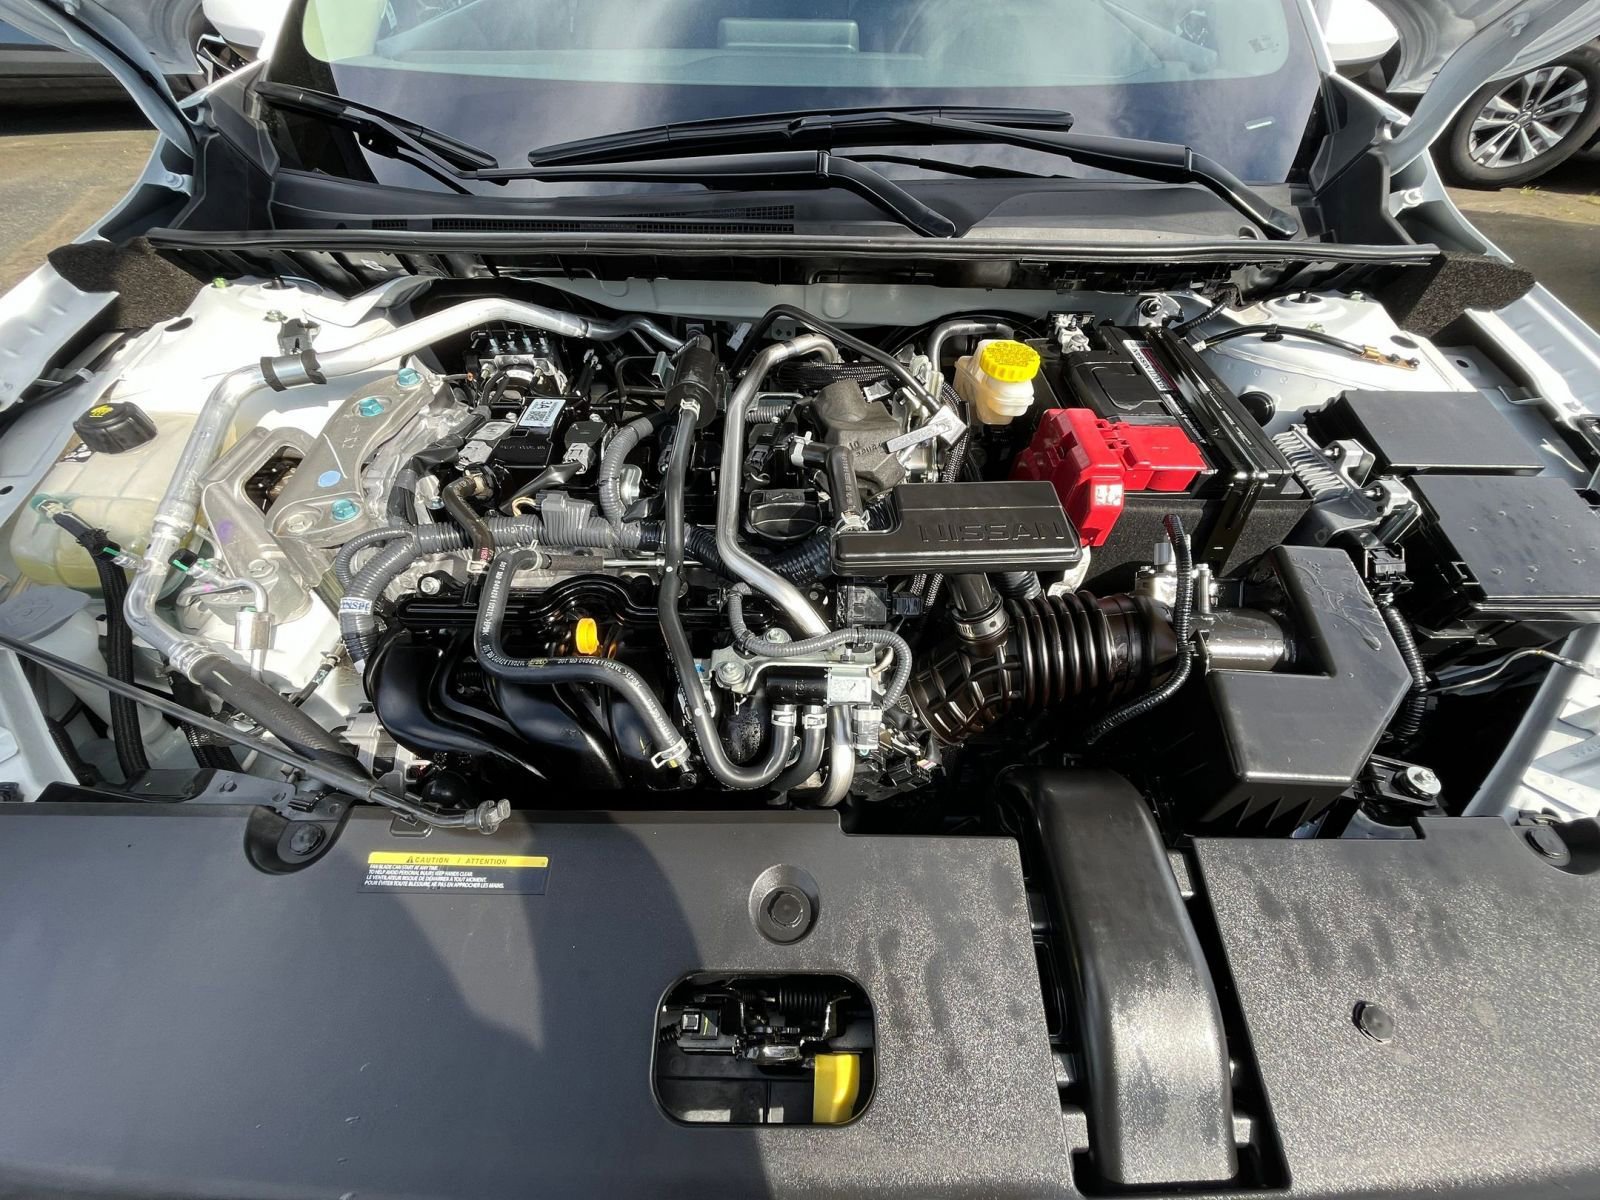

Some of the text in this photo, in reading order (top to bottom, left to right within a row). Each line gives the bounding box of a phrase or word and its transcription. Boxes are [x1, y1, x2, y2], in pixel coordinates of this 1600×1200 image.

[918, 521, 1065, 542] NISSAN
[414, 856, 450, 864] CAUTION
[465, 857, 508, 865] ATTENTION
